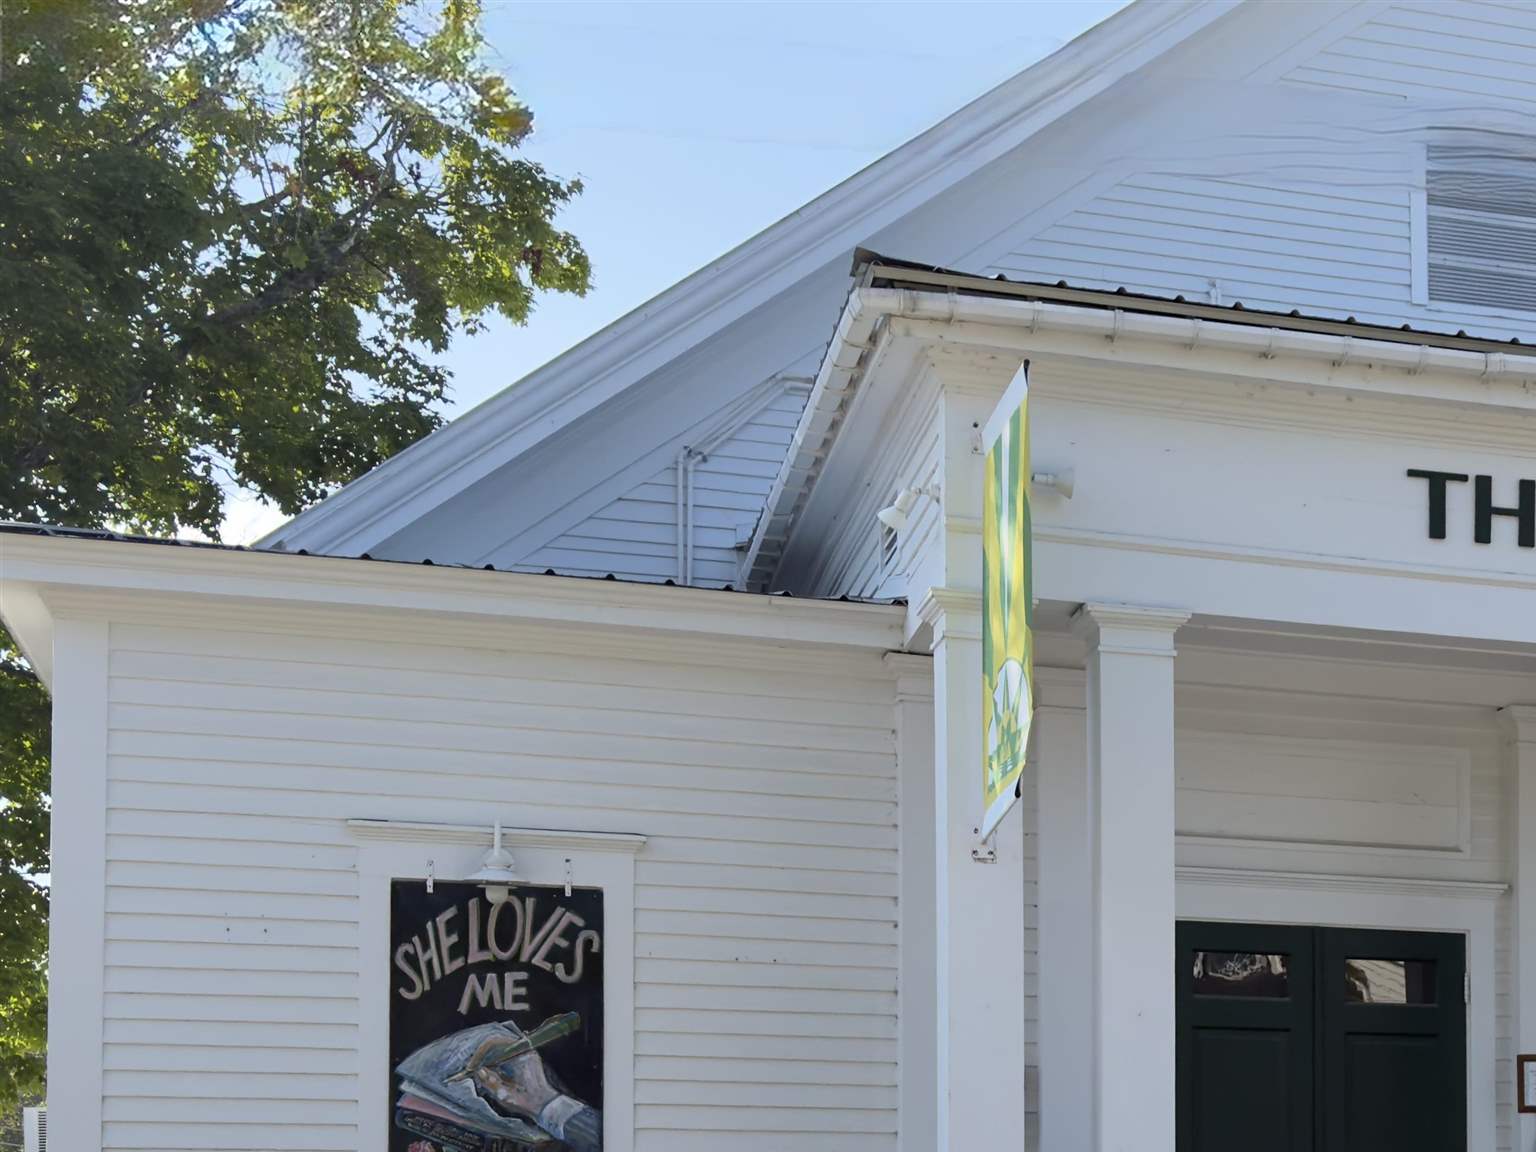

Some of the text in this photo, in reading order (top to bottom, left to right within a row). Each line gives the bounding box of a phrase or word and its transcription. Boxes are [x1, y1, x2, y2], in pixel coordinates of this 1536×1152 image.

[394, 895, 601, 1000] SHE LOVES
[456, 971, 531, 1015] ME
